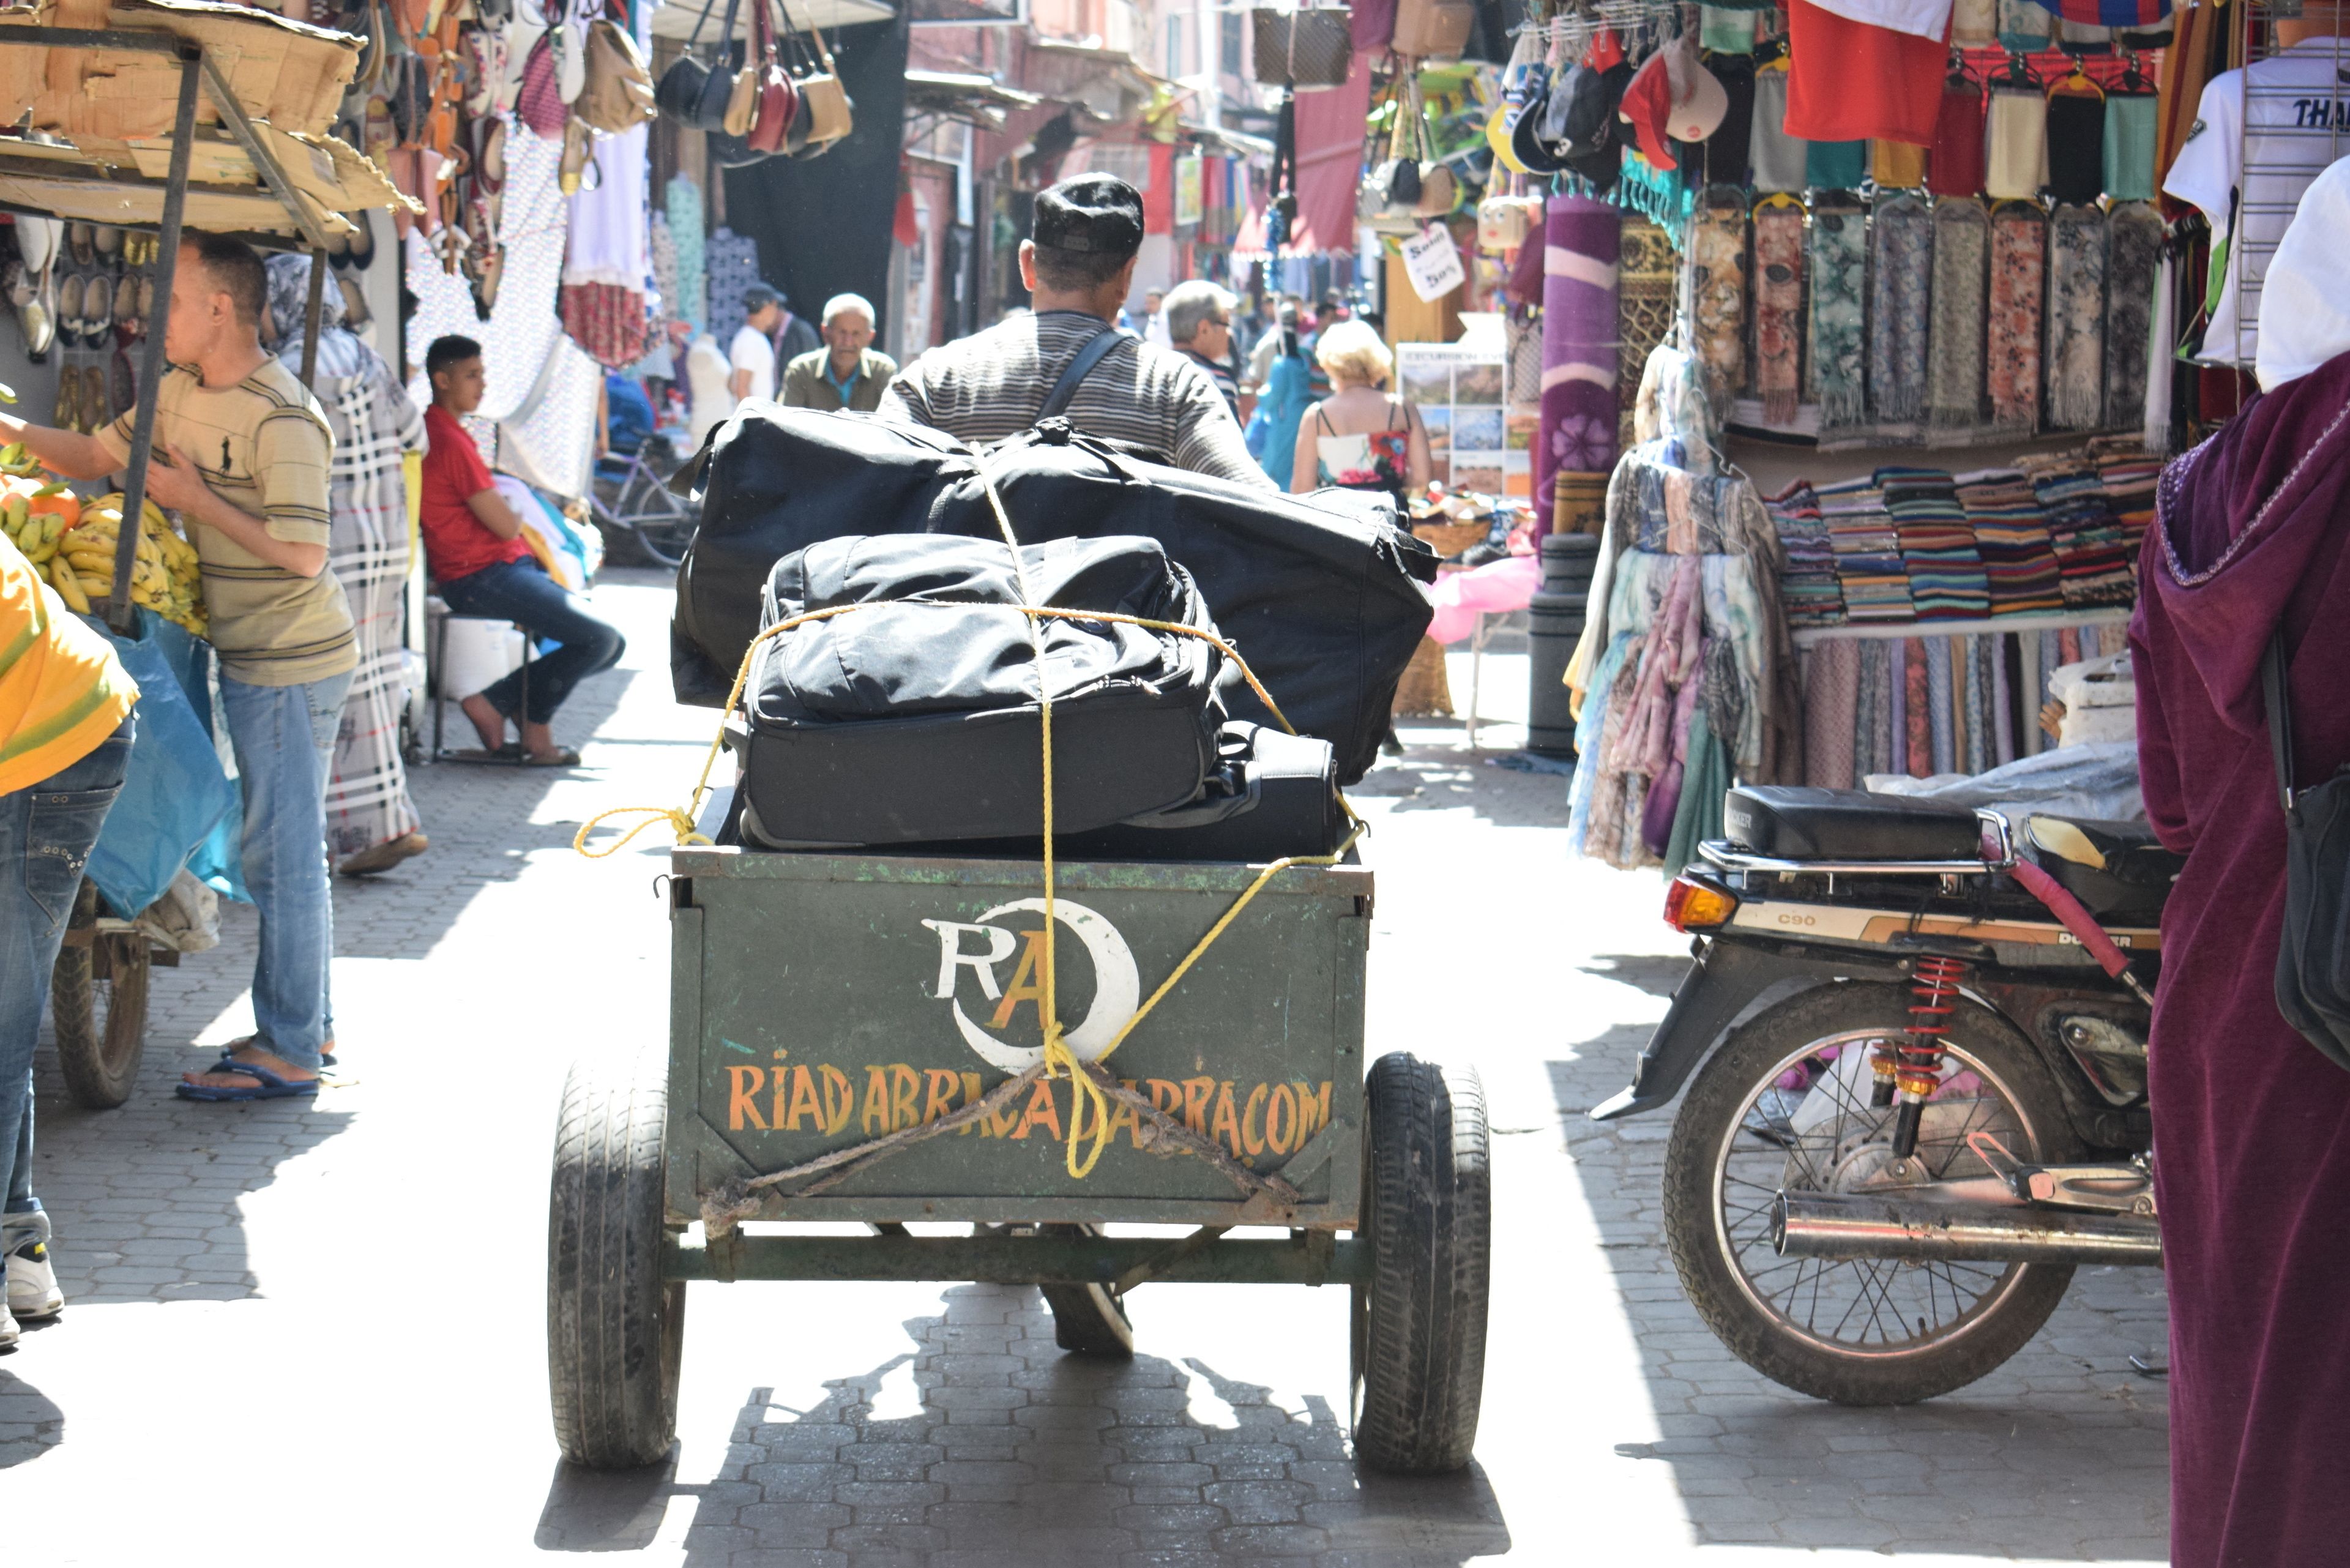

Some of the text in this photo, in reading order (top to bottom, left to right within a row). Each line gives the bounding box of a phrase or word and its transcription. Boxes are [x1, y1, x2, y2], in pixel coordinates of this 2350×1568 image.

[2292, 99, 2350, 132] THA
[1778, 914, 1816, 926] C90
[2058, 932, 2132, 947] DOER
